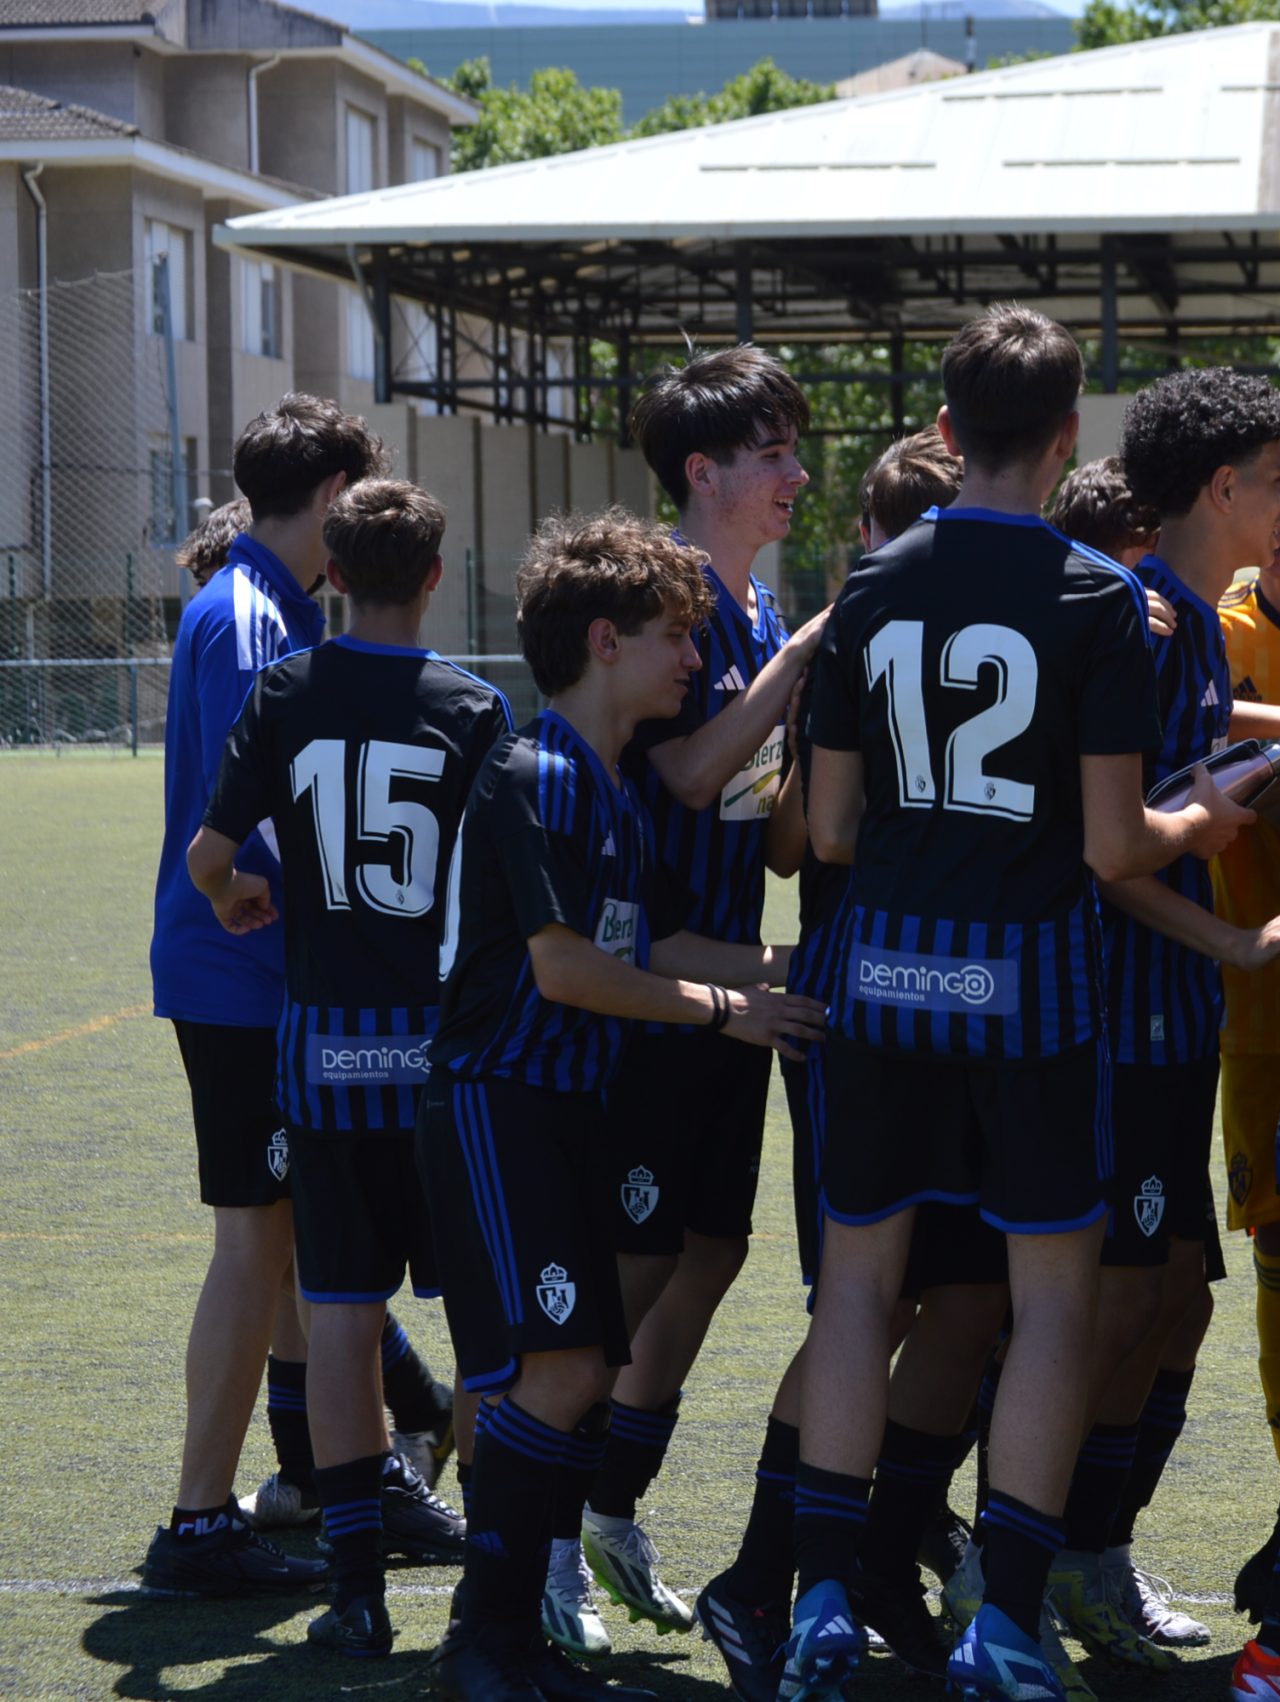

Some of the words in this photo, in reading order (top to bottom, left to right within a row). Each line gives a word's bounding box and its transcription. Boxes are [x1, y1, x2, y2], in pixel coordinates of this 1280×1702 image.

[863, 619, 1038, 822] 12
[289, 738, 447, 918] 15
[858, 985, 925, 1002] equipamientos
[322, 1071, 389, 1080] equipamientos
